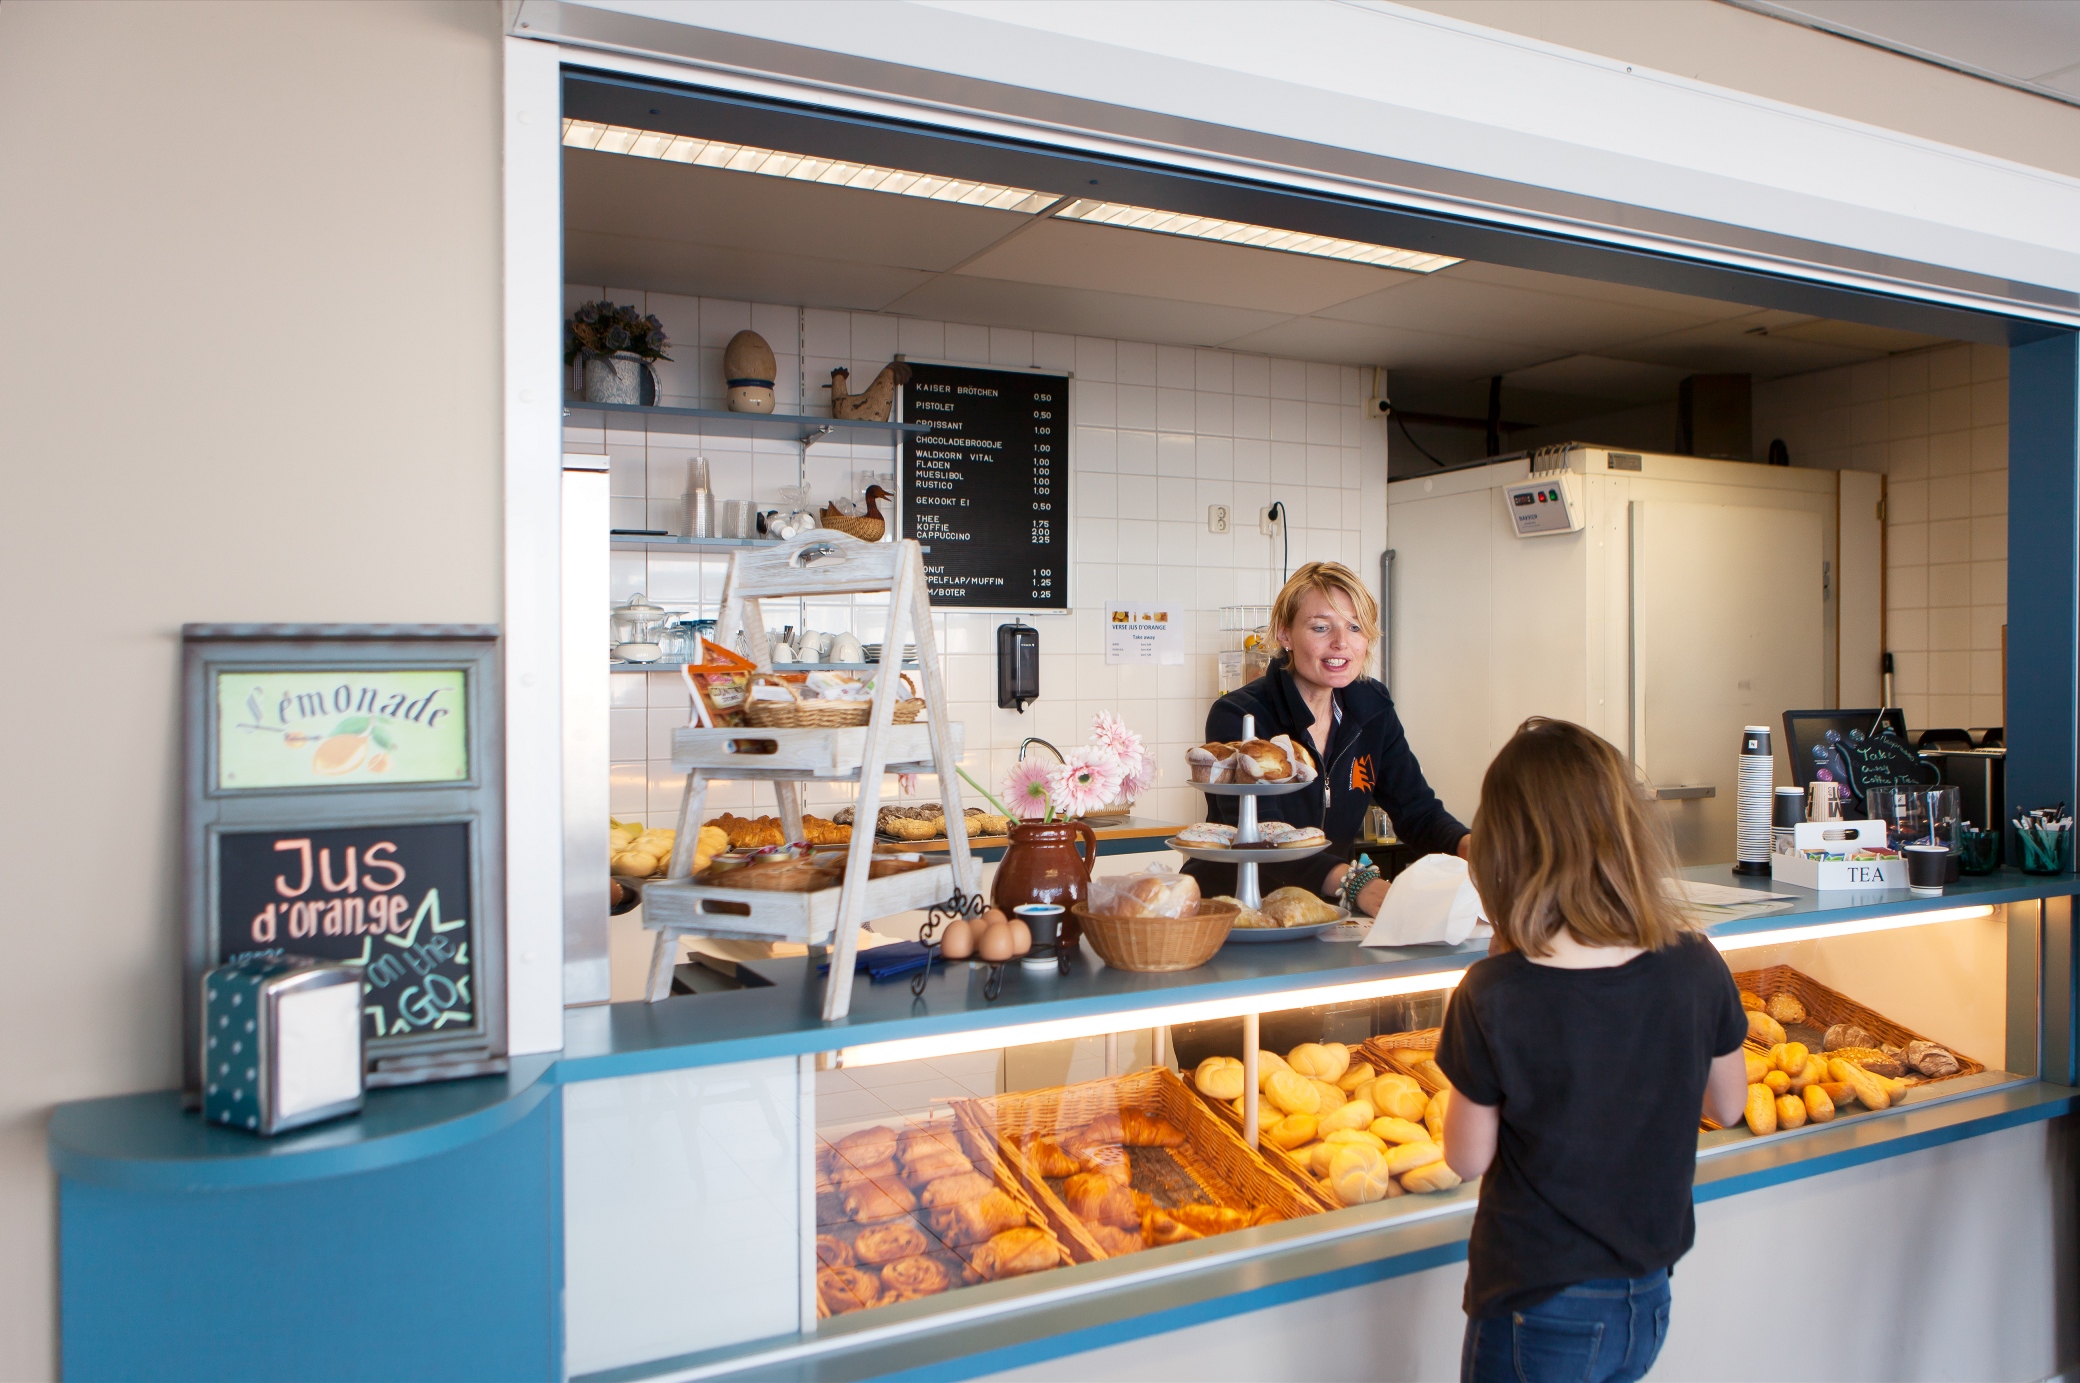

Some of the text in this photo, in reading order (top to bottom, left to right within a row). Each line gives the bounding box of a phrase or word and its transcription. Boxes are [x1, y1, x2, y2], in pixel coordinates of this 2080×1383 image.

[916, 383, 999, 397] KAISER BRÖTCHEN
[916, 401, 954, 411] PISTOLET
[916, 436, 1002, 449] CHOCOLADEBROODJE
[916, 450, 994, 462] WALDKORN VITAL
[916, 460, 950, 469] FLADEN
[916, 471, 964, 480] MUESLIBOL
[916, 481, 953, 490] RUSTICO
[916, 496, 970, 507] GEKOOKT EI
[916, 515, 939, 523] THEE
[916, 523, 950, 531] KOFFIE
[916, 531, 971, 540] CAPPUCCINO
[923, 566, 944, 574] ONUT
[923, 577, 1004, 586] PPELFLAP/MUFFIN
[1857, 746, 1896, 761] Take
[1862, 775, 1891, 784] Coffee
[1898, 774, 1919, 784] Tea
[273, 838, 406, 898] Jus
[1847, 867, 1885, 883] TEA
[251, 894, 413, 943] d'orange
[403, 934, 456, 976] the
[398, 973, 458, 1026] GO
